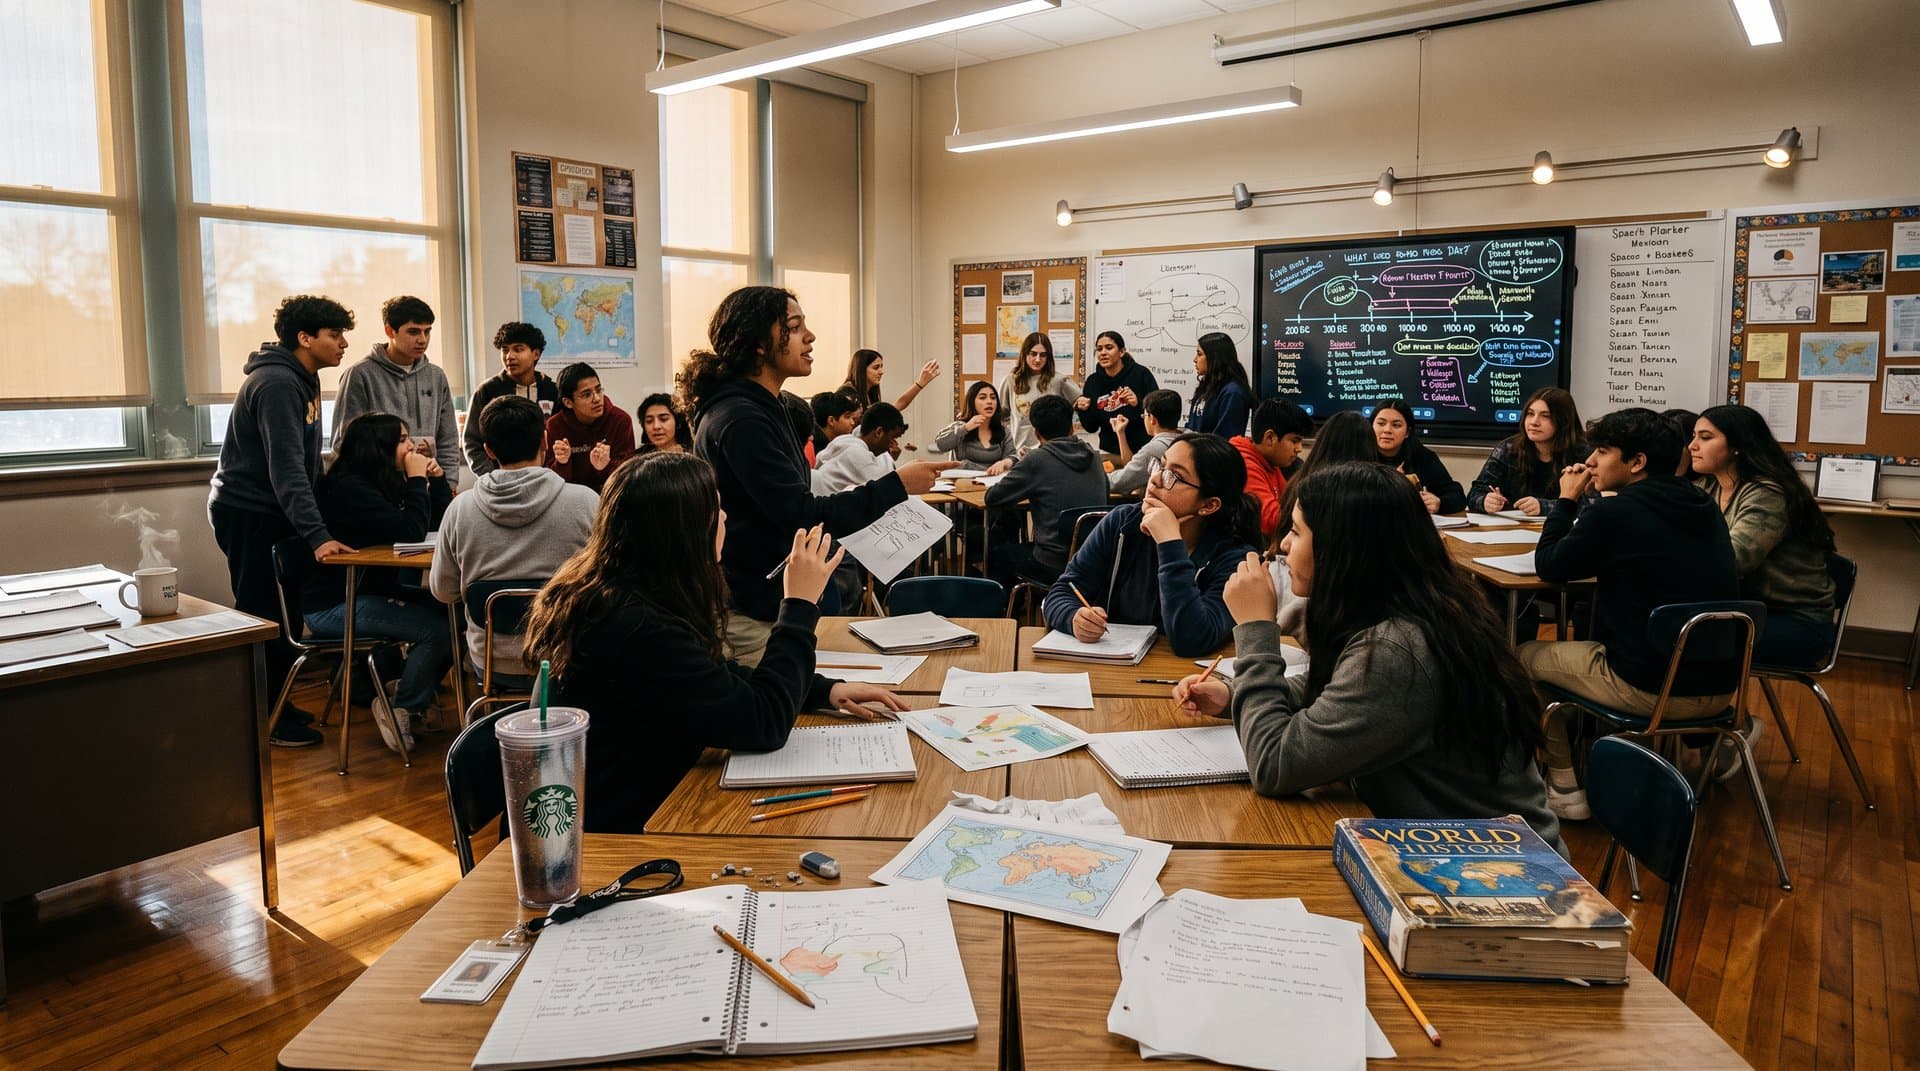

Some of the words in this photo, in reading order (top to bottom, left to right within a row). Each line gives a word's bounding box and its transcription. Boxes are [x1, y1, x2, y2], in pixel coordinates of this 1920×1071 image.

[1285, 326, 1298, 335] 200
[1416, 324, 1428, 332] AD
[1367, 828, 1521, 844] WORLD
